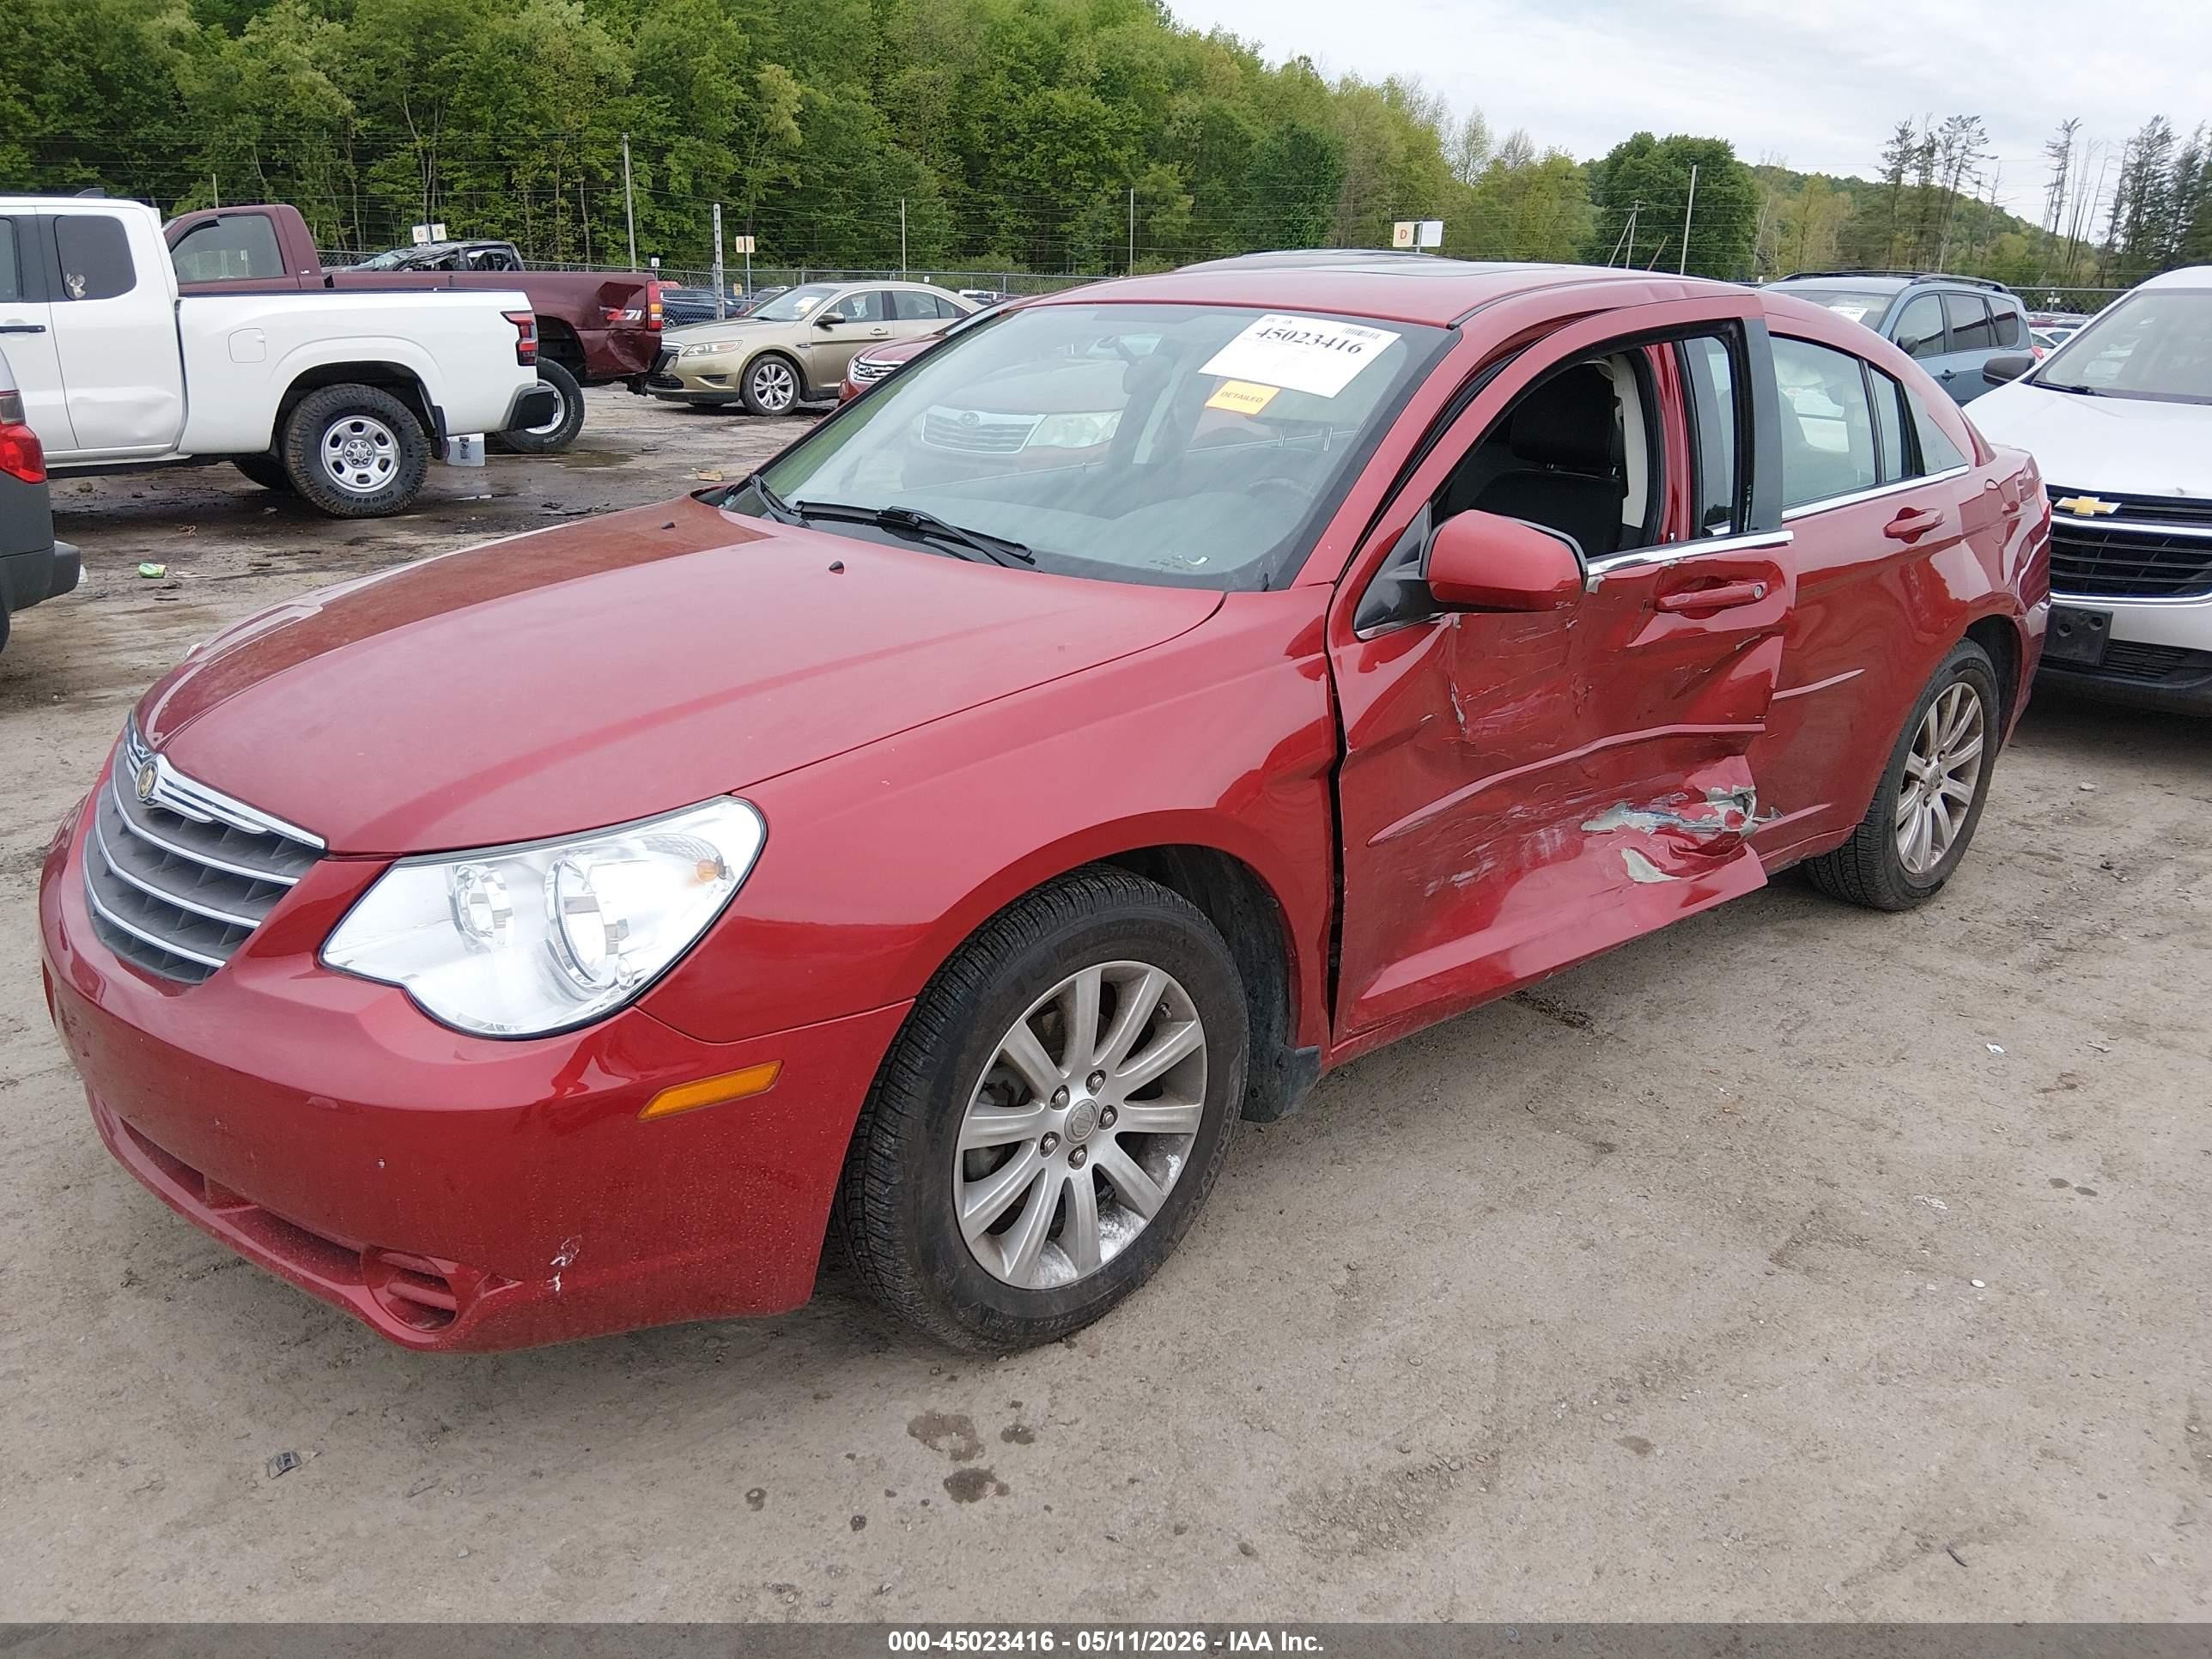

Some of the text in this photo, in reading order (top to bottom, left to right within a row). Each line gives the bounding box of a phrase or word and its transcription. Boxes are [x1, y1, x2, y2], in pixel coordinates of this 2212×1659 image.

[1400, 228, 1408, 240] D
[603, 307, 642, 321] Z71
[1255, 326, 1365, 355] 45023416
[1219, 391, 1264, 404] DETAILED
[325, 484, 394, 504] CROSSWIND
